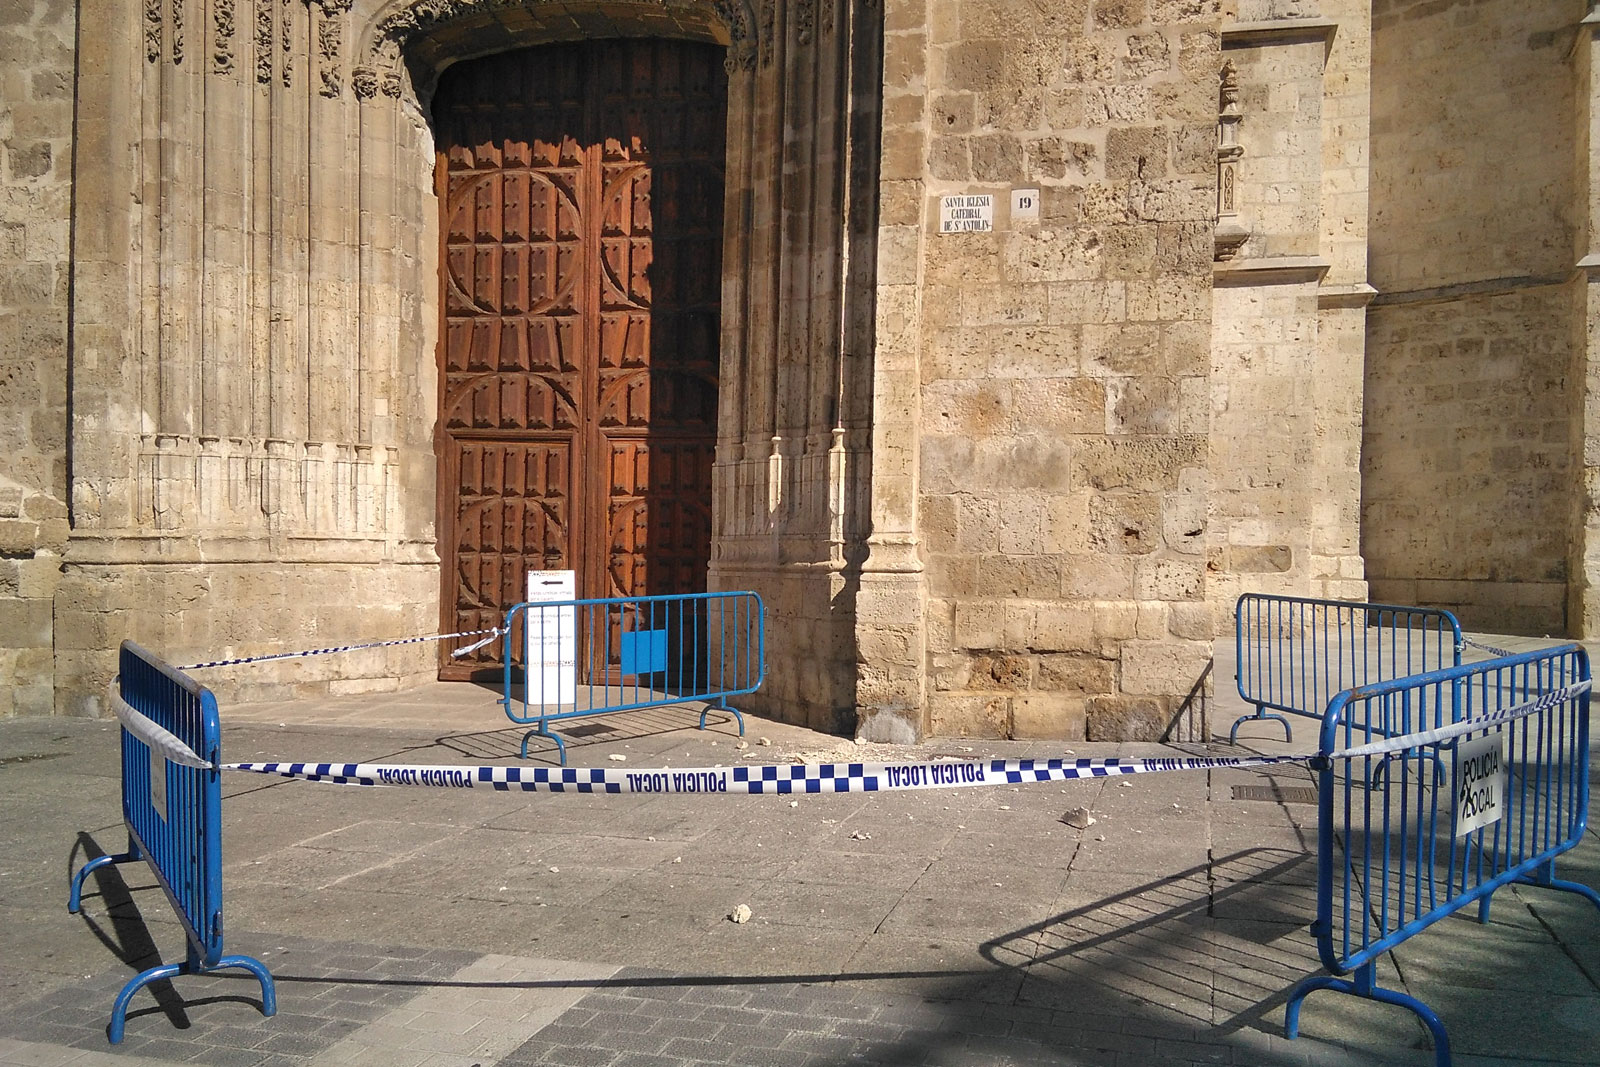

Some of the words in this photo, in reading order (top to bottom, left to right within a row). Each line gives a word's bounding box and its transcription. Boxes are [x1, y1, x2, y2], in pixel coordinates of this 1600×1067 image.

[945, 196, 964, 208] SANTA
[966, 196, 990, 207] IGLESIA
[1018, 197, 1032, 209] 19
[951, 208, 982, 219] CATEDRAL
[944, 220, 953, 231] DE
[1463, 745, 1498, 783] POLICÍA
[376, 768, 420, 786] LOCAL
[420, 769, 474, 788] POLICIA
[626, 773, 669, 792] LOCAL
[672, 772, 727, 792] POLICIA
[884, 765, 927, 787] LOCAL
[930, 763, 985, 785] POLICIA
